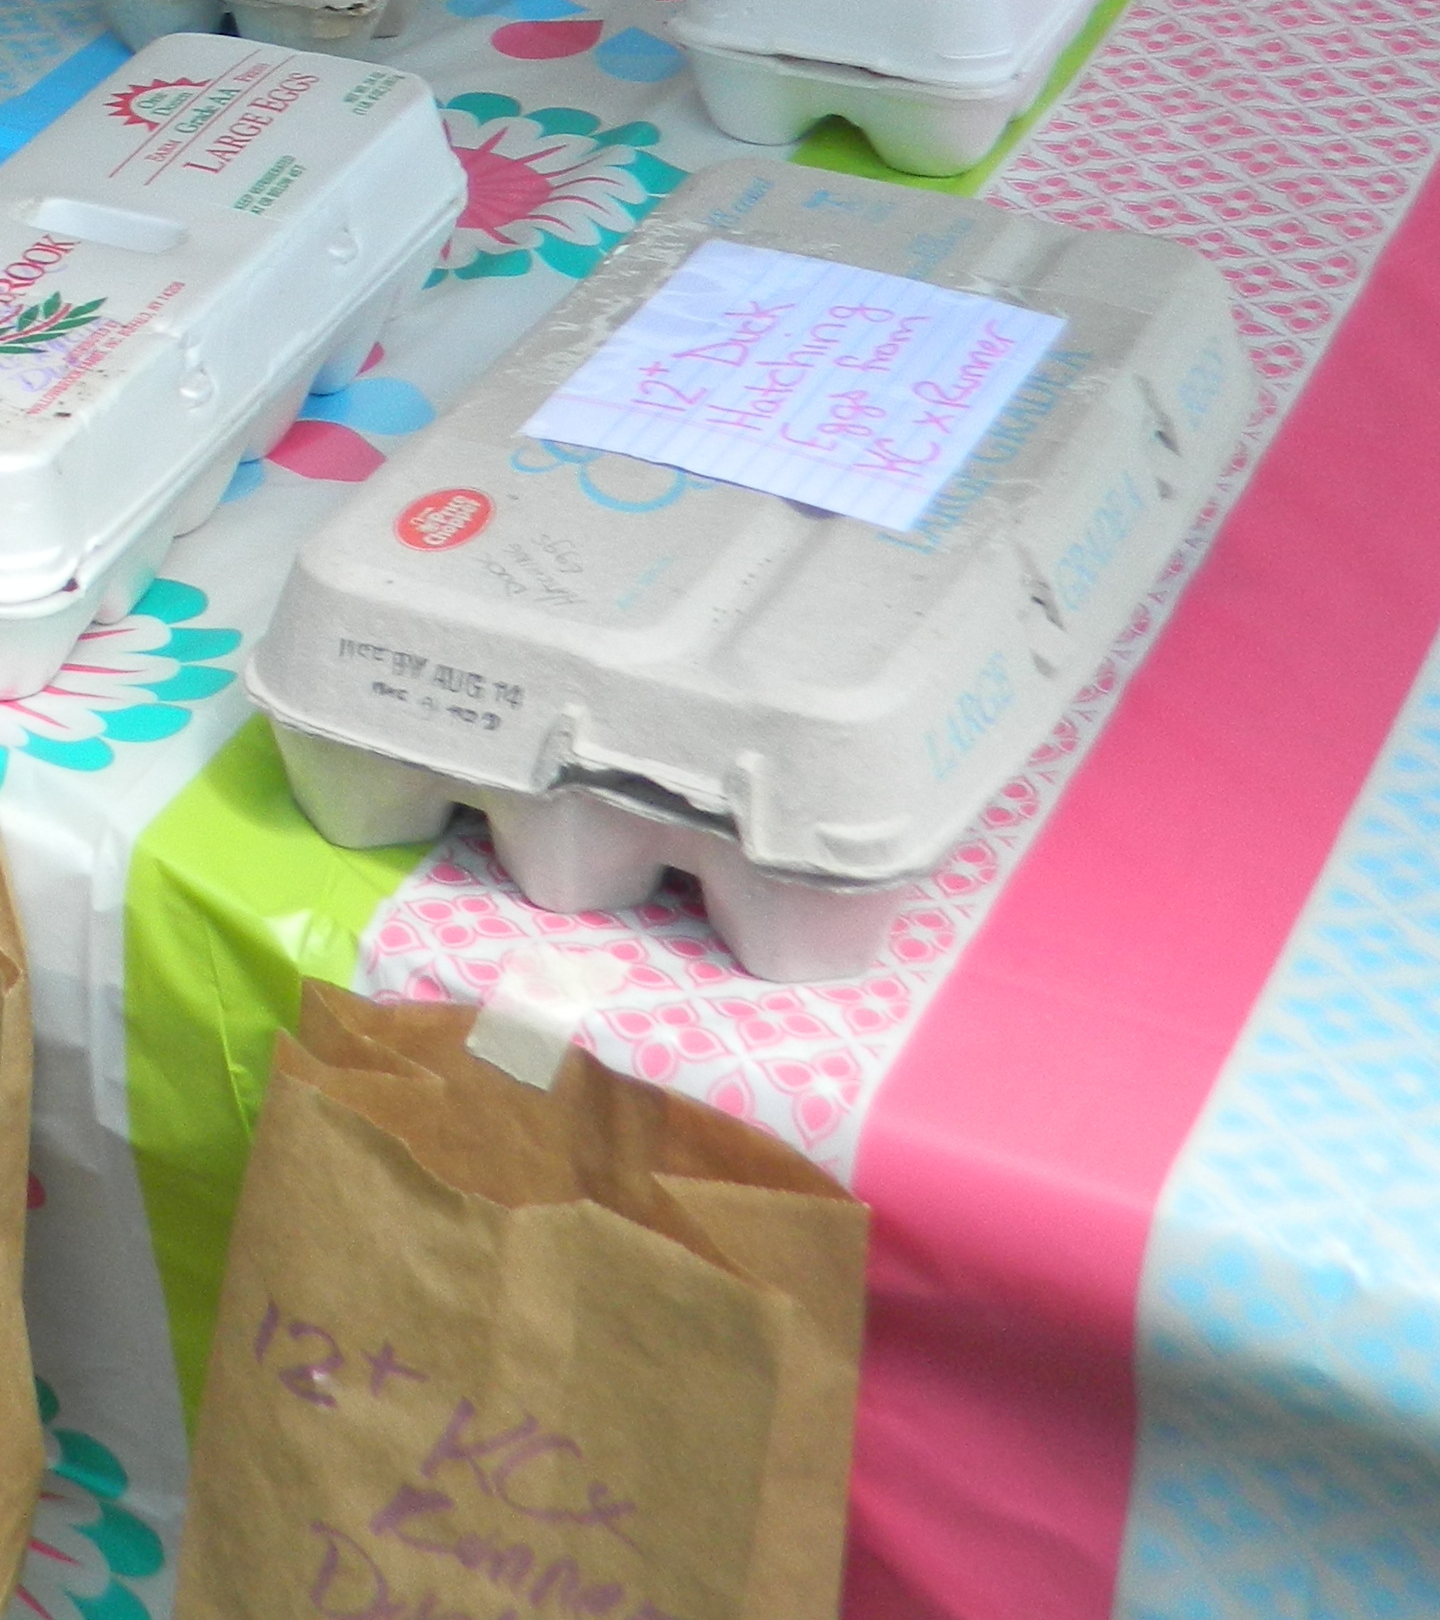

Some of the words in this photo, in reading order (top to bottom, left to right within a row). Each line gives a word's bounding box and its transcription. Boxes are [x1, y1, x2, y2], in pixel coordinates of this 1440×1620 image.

[138, 90, 168, 110] One
[153, 90, 195, 117] Dozen
[174, 102, 216, 135] Grade
[208, 86, 243, 107] AA
[182, 112, 275, 175] LARGE
[248, 71, 321, 115] EGGS
[671, 300, 796, 368] Duck
[705, 300, 896, 431] Hatching
[832, 313, 931, 375] from
[780, 386, 888, 452] Eggs
[853, 437, 943, 479] KC
[912, 319, 1019, 409] Runner
[431, 663, 486, 700] AUG
[492, 680, 526, 710] 14
